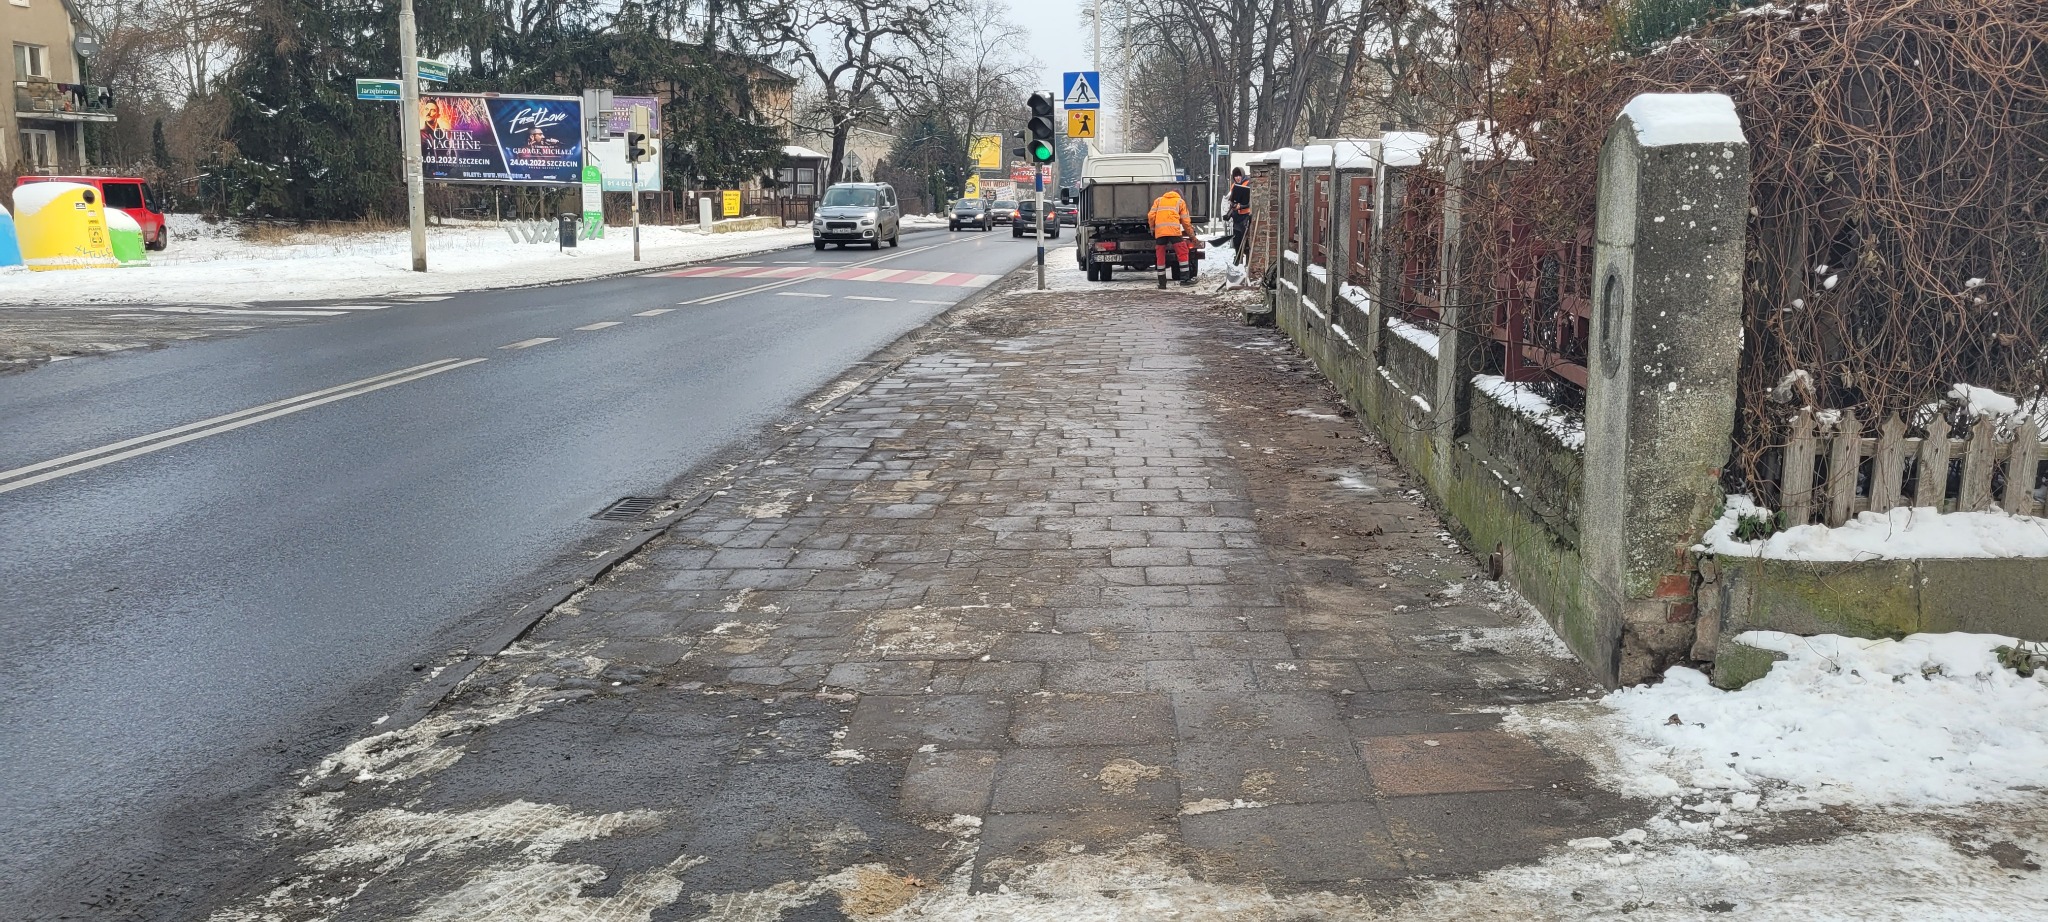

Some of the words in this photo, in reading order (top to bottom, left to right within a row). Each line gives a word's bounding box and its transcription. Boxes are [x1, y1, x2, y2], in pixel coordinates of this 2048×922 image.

[361, 87, 398, 95] Jarzębinowa
[427, 139, 481, 150] MACHINE
[513, 147, 541, 155] GEORGE
[543, 148, 574, 156] MICHAEL
[510, 158, 546, 167] 24.04.2022
[546, 160, 578, 168] SZCZECIN
